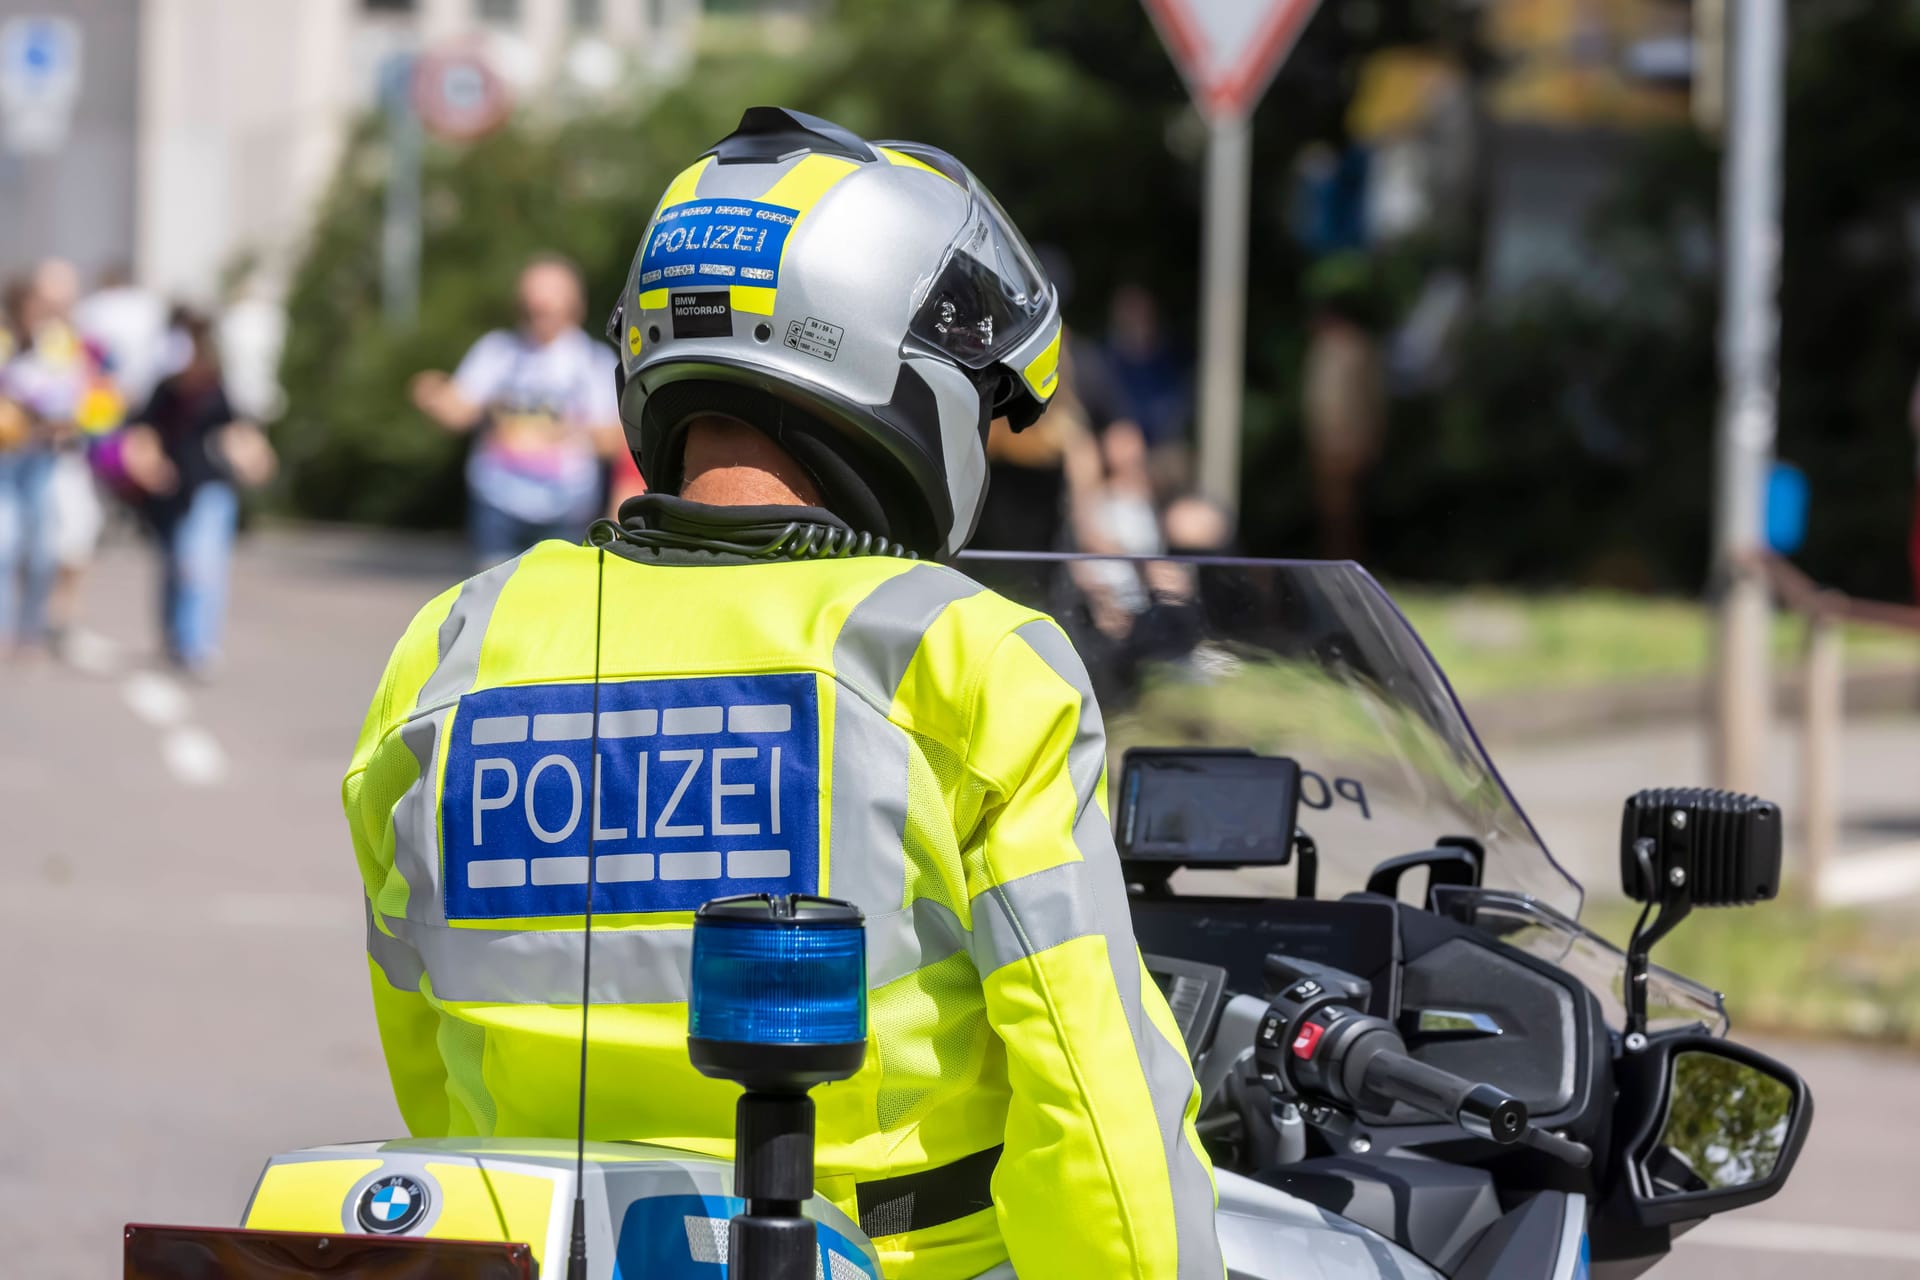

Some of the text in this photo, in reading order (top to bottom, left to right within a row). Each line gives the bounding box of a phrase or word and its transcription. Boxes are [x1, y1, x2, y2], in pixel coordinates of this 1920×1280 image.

[651, 225, 767, 257] POLIZEI
[674, 296, 696, 305] BMW
[675, 305, 726, 316] MOTORRAD
[472, 746, 781, 846] POLIZEI
[370, 1177, 419, 1196] BMW
